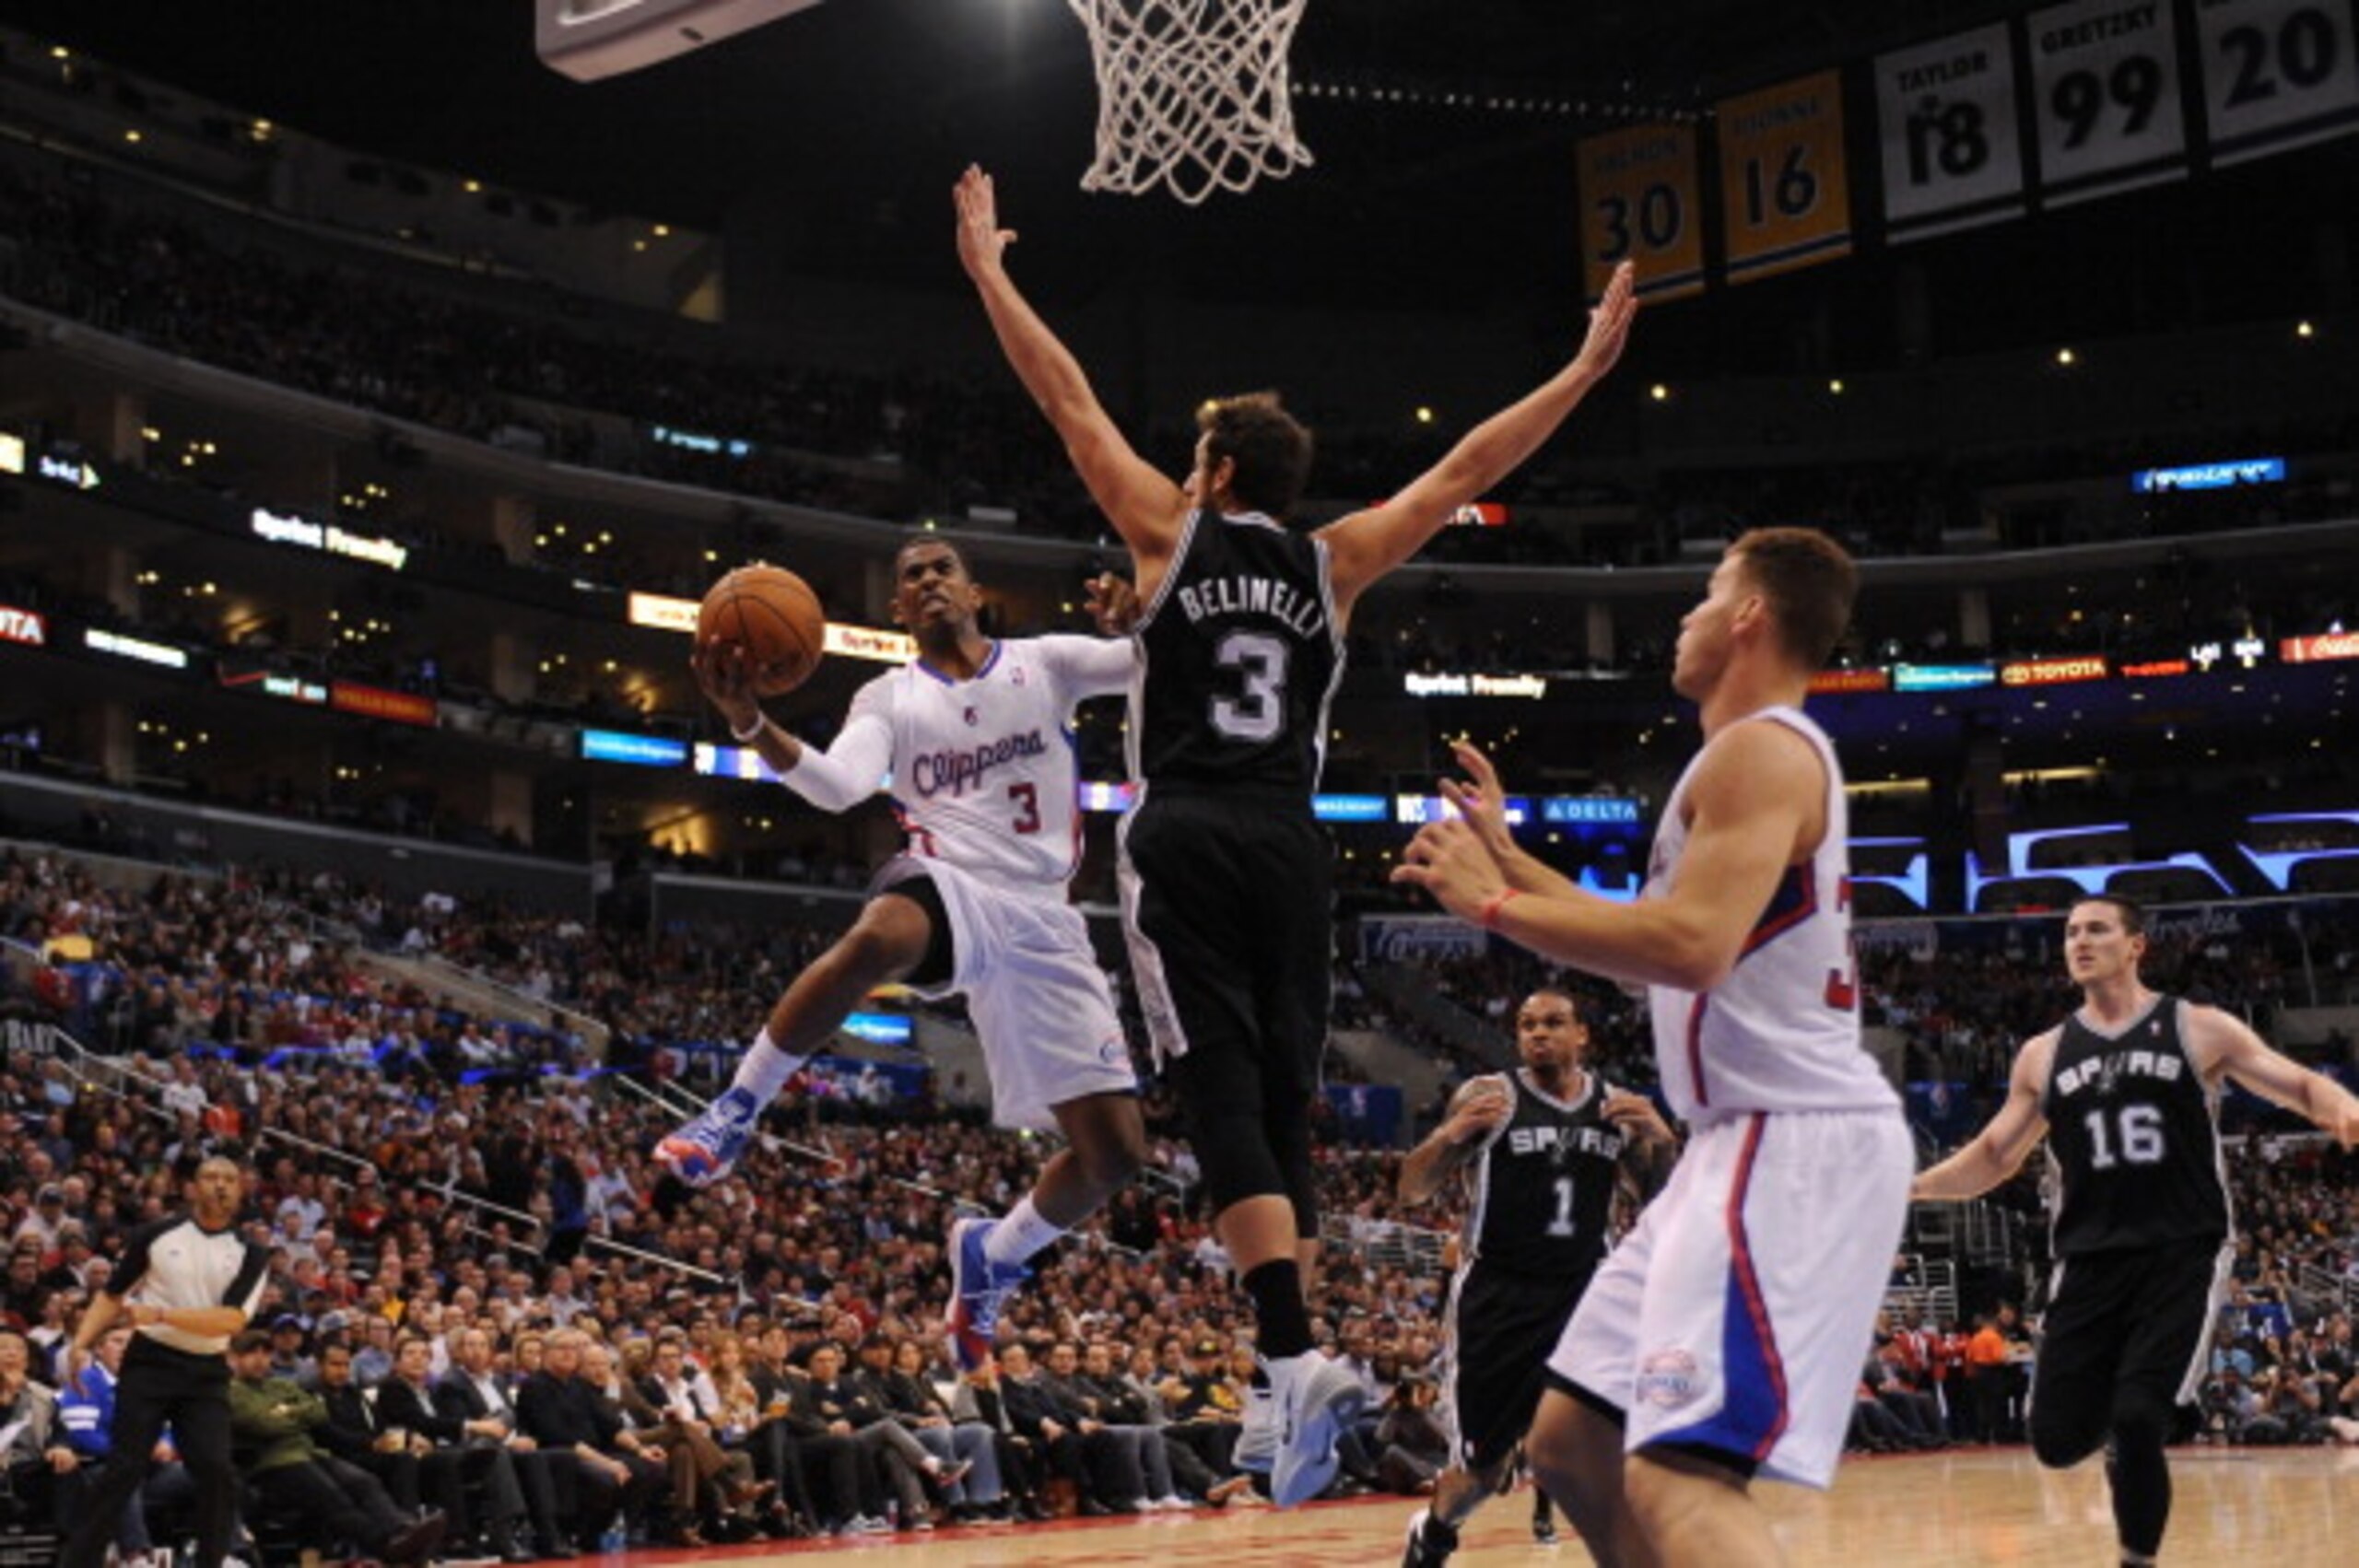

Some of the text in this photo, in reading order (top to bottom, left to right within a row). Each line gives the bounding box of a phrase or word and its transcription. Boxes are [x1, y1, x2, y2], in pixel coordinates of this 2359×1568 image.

[2040, 7, 2157, 53] GRETZKY
[2218, 8, 2337, 109] 20
[1896, 52, 1988, 93] TAYLOR
[2051, 55, 2164, 150] 99
[1906, 100, 1989, 186] 18
[1747, 144, 1815, 224] 16
[1597, 183, 1682, 263] 30
[1179, 575, 1324, 639] BELINELLI
[1212, 630, 1288, 742] 3
[2032, 657, 2106, 680] TOYOTA
[912, 729, 1048, 800] Clippers
[1007, 781, 1041, 835] 3
[1567, 801, 1637, 819] DELTA
[2056, 1050, 2183, 1096] SPURS
[1508, 1126, 1621, 1163] SPURS
[2083, 1103, 2165, 1170] 16
[1544, 1176, 1575, 1236] 1
